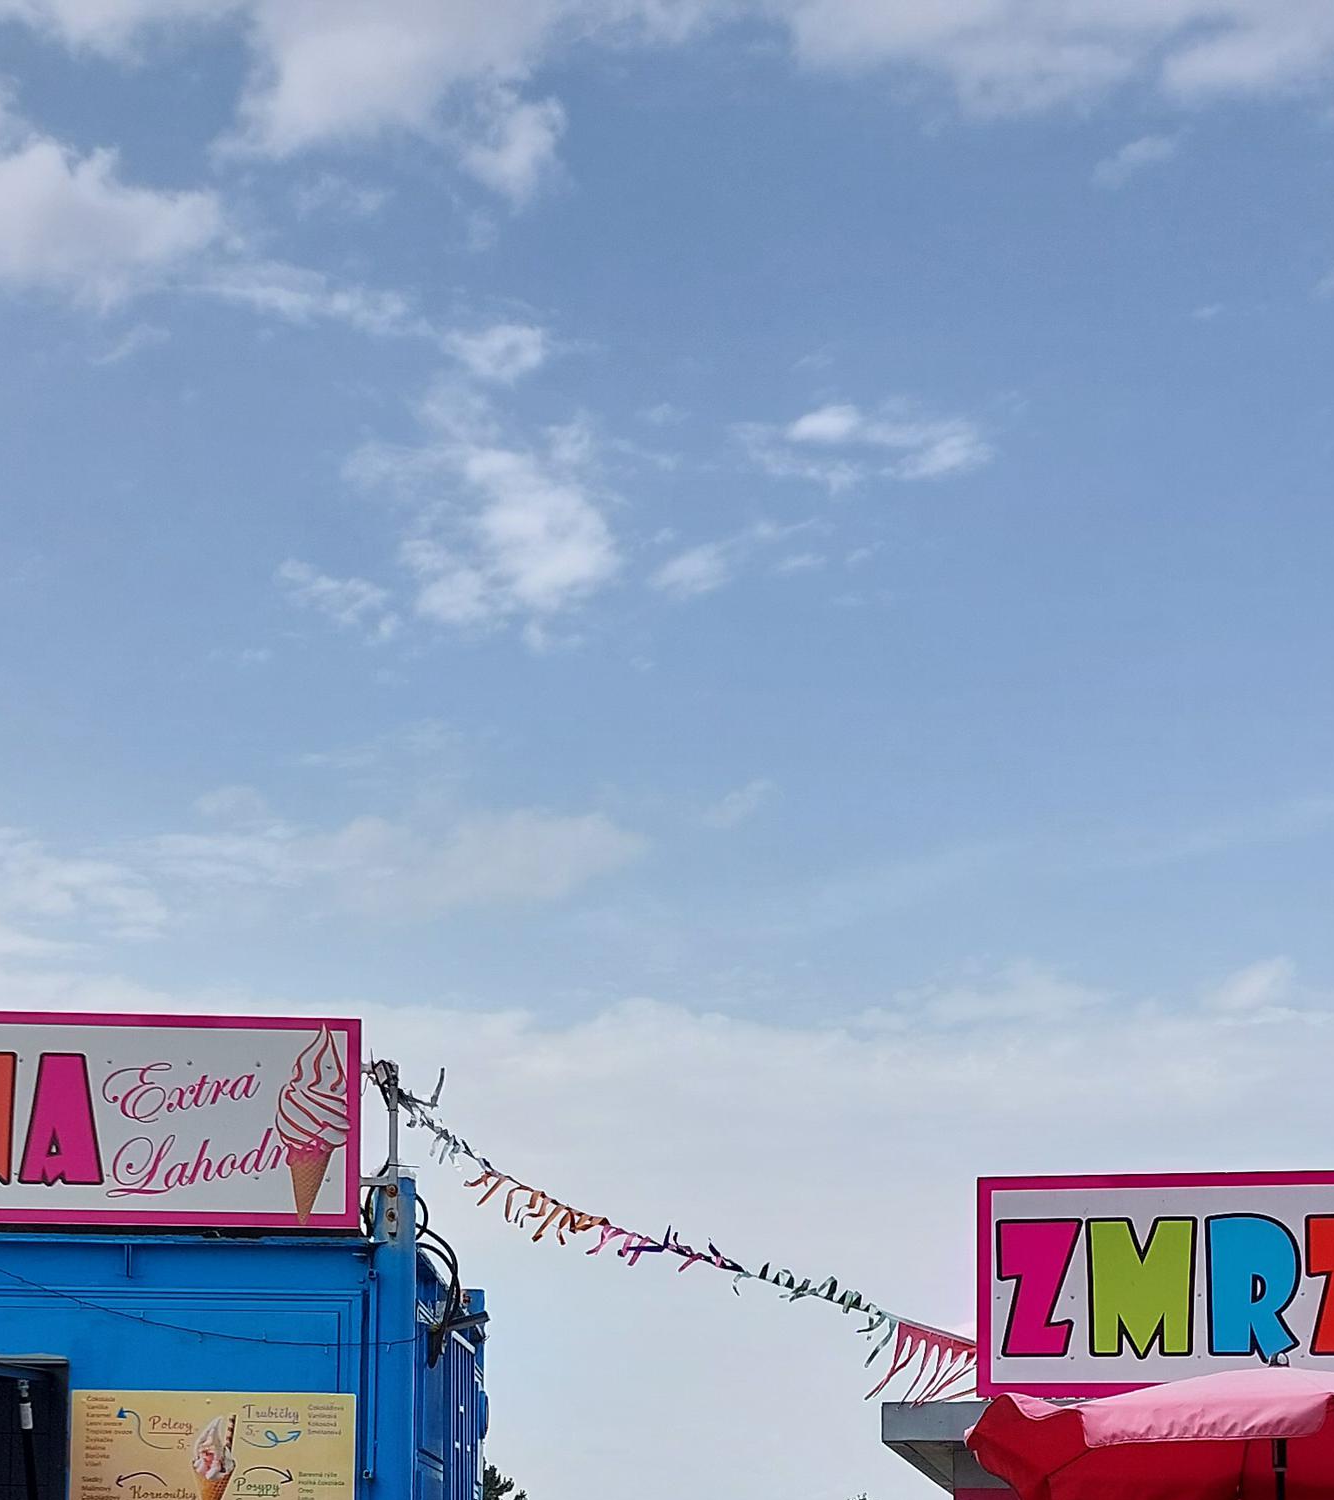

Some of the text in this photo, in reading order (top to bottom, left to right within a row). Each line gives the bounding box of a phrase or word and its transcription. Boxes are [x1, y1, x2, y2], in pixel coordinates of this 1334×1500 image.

[103, 1062, 261, 1123] Extra
[242, 1404, 299, 1424] Trubičky
[148, 1415, 192, 1435] Polevy
[233, 1477, 280, 1497] Posypy
